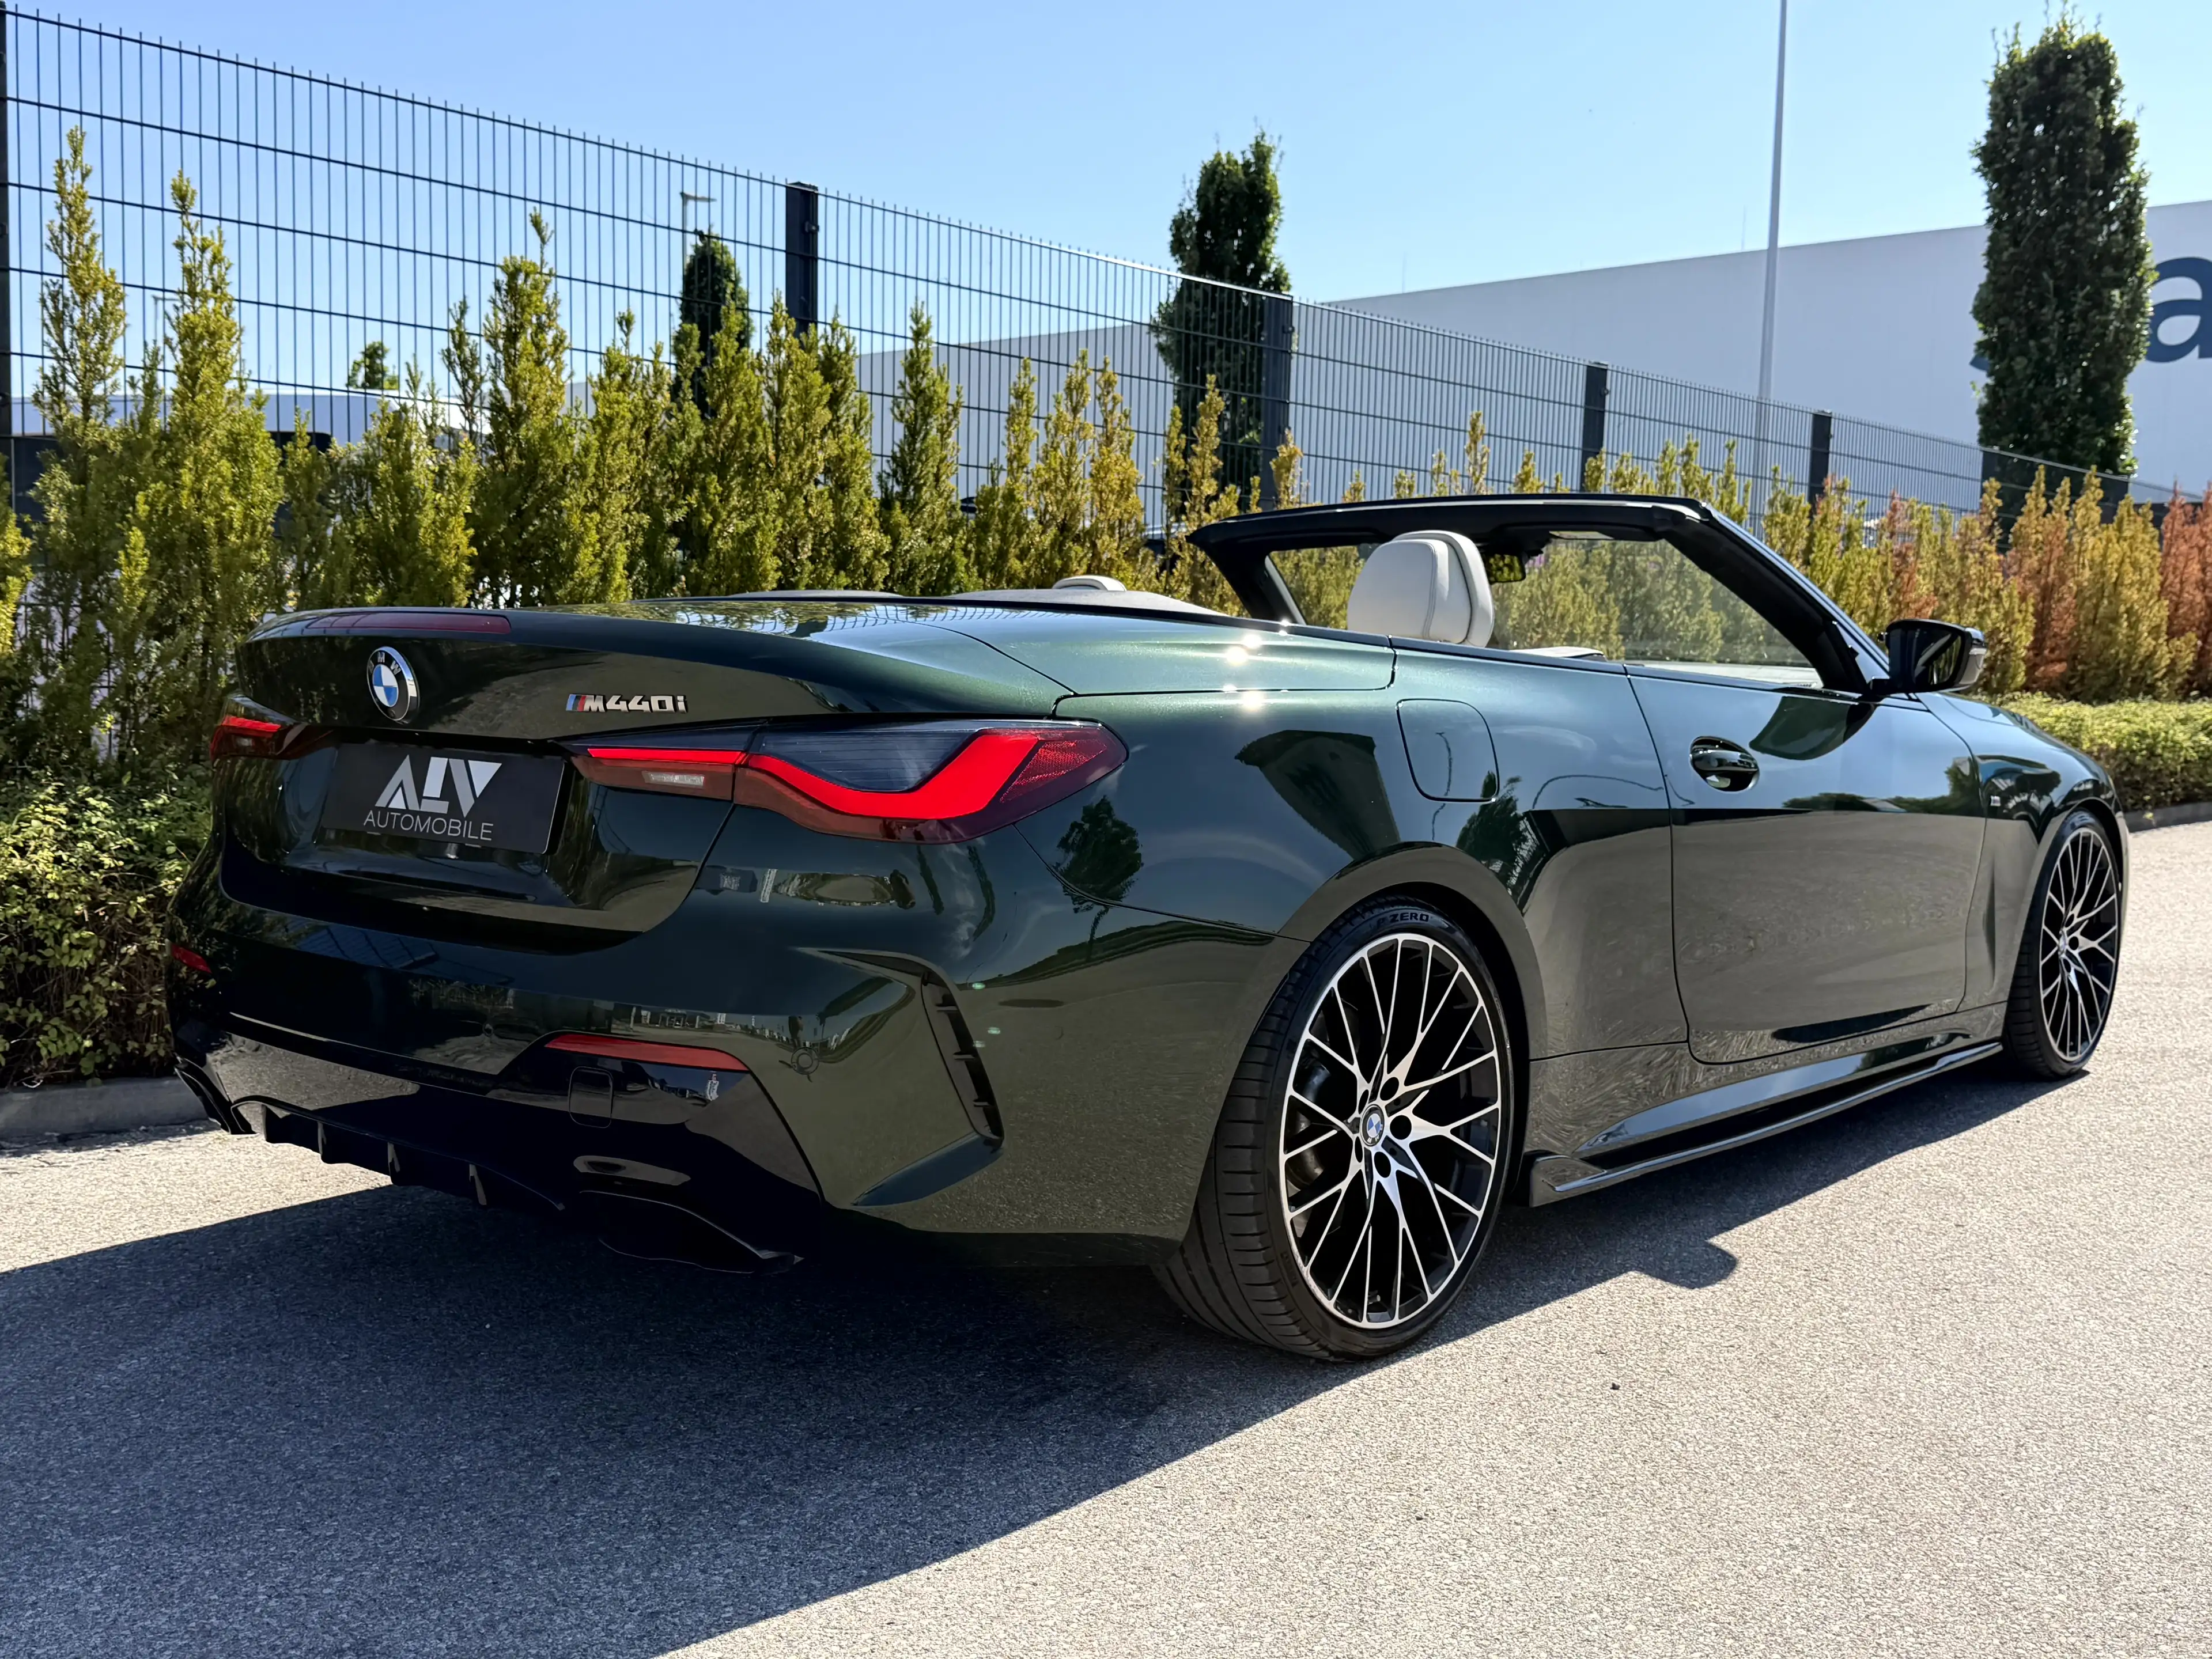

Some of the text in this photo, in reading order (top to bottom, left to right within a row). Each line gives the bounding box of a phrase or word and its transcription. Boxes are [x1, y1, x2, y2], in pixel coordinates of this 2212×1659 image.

[583, 694, 687, 713] M440i
[364, 810, 494, 841] AUTOMOBILE
[1389, 912, 1430, 923] ZERO
